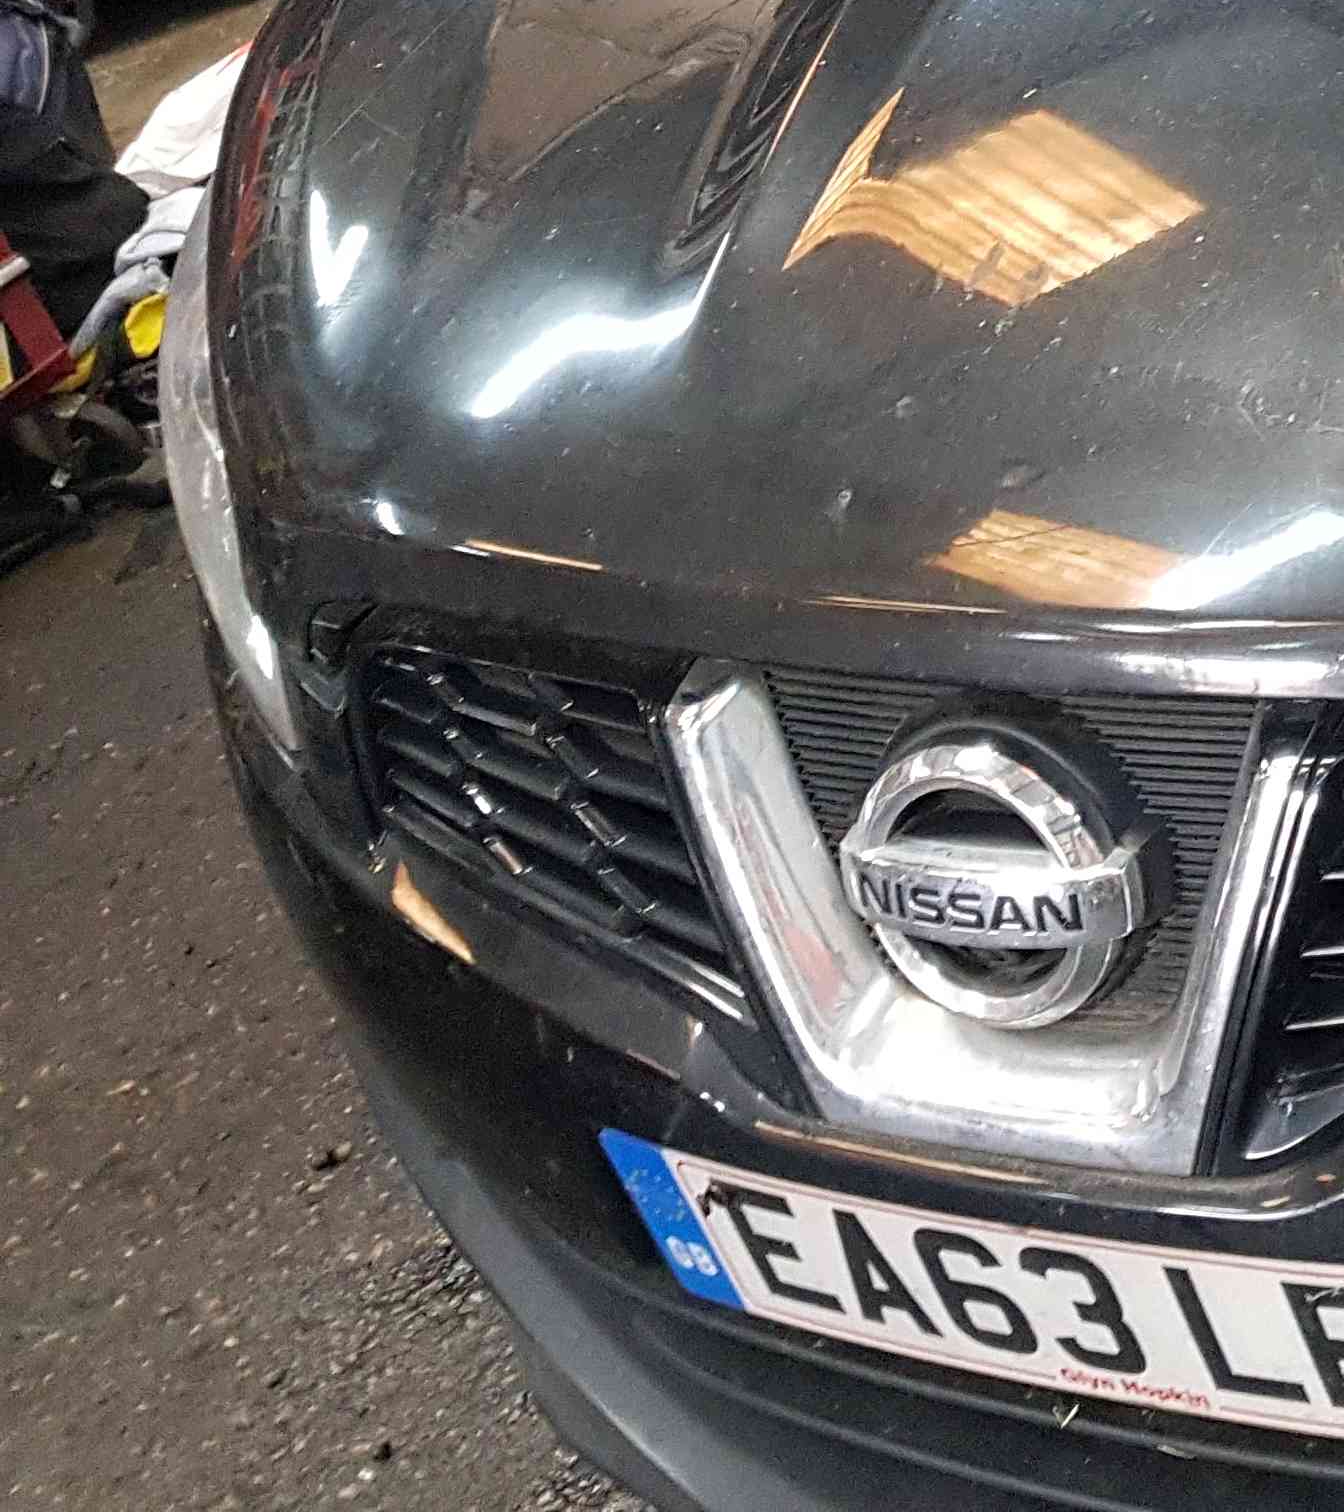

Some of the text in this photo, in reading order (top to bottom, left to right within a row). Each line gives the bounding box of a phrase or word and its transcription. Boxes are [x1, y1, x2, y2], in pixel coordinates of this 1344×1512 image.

[859, 871, 1085, 933] NISSAN
[665, 1235, 719, 1277] GB
[706, 1179, 1147, 1375] EA63
